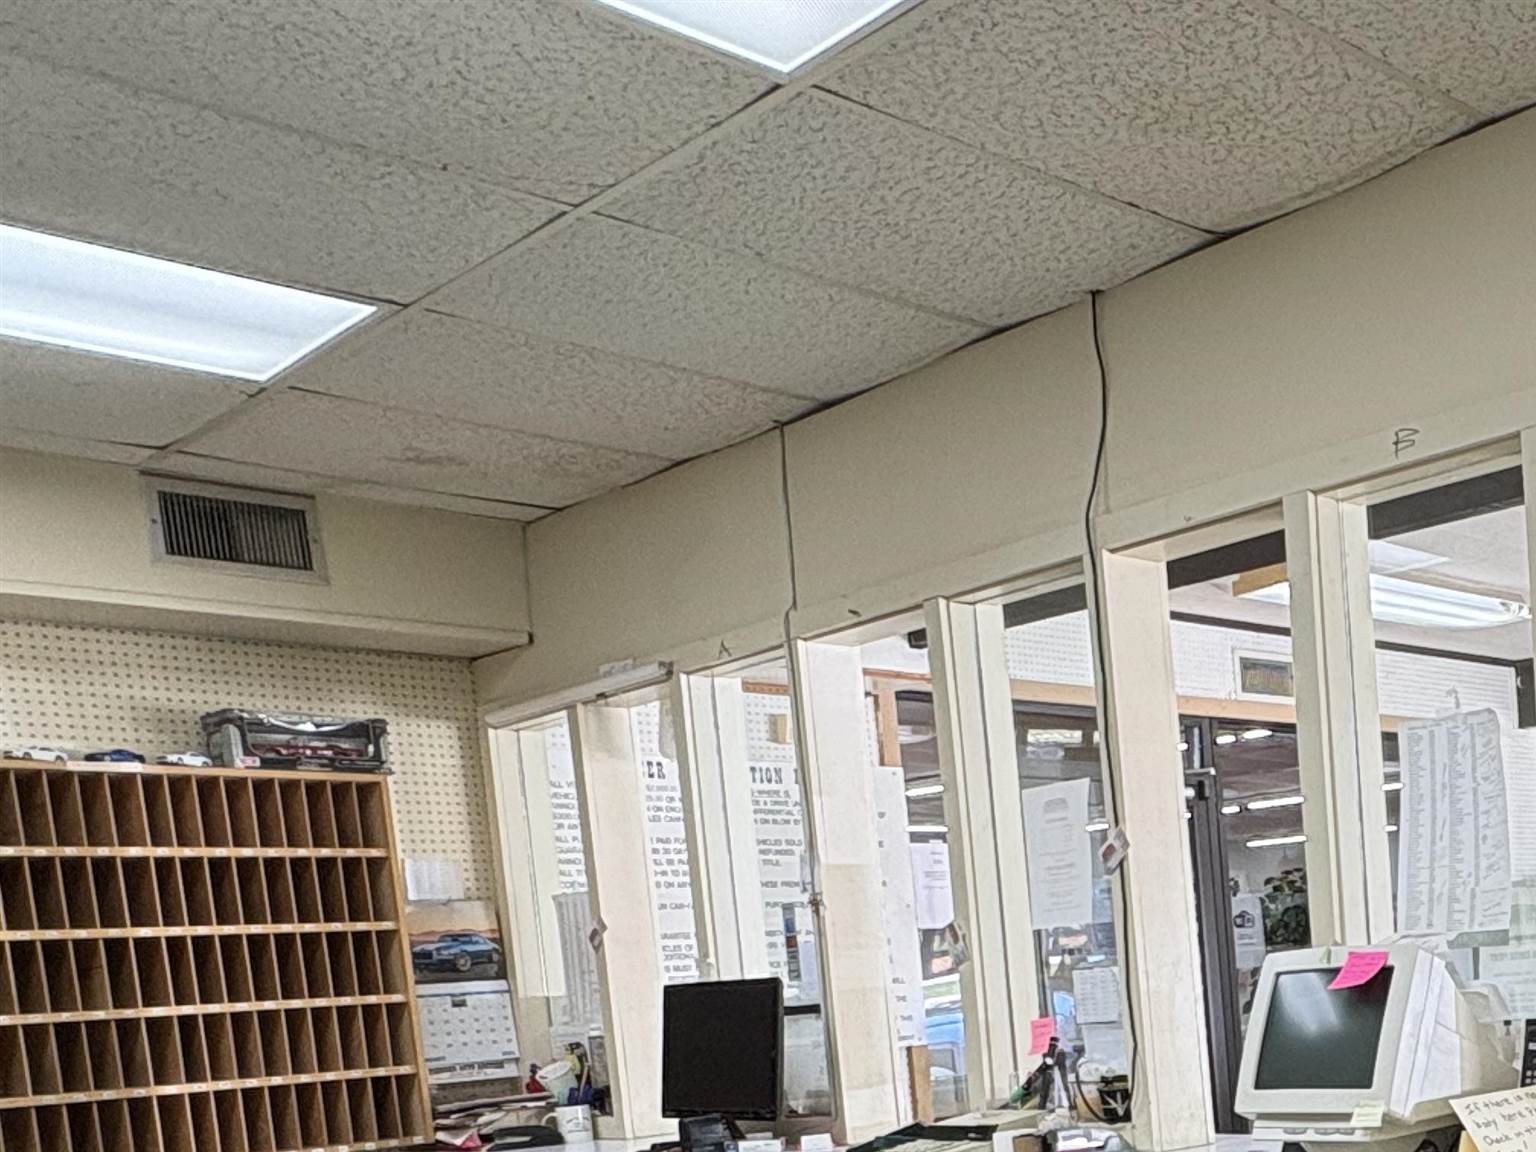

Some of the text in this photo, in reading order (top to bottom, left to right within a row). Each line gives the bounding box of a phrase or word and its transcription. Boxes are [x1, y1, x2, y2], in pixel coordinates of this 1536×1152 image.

[749, 766, 783, 784] TION
[1483, 1096, 1512, 1112] there
[1500, 1111, 1527, 1123] here
